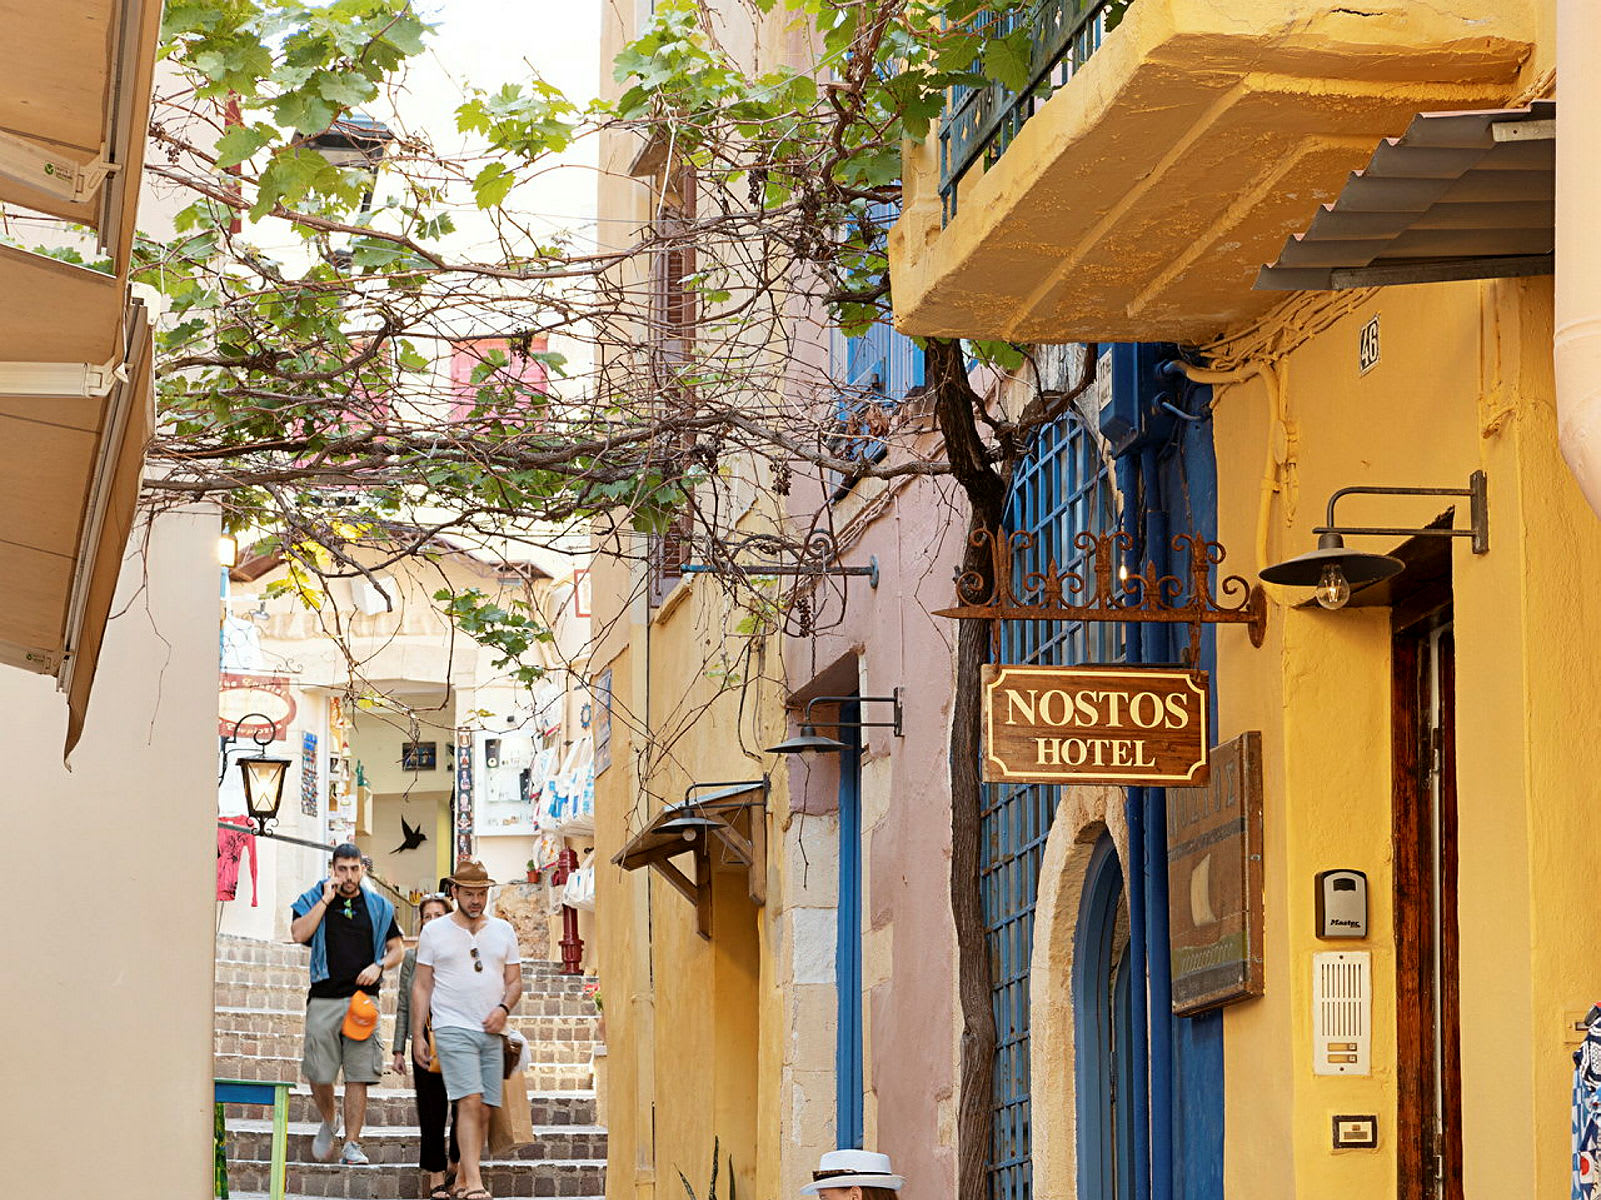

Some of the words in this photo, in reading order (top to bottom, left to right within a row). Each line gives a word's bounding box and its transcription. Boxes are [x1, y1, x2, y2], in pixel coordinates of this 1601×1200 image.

[1361, 323, 1378, 367] 46
[1005, 689, 1189, 729] NOSTOS
[1035, 737, 1156, 767] HOTEL
